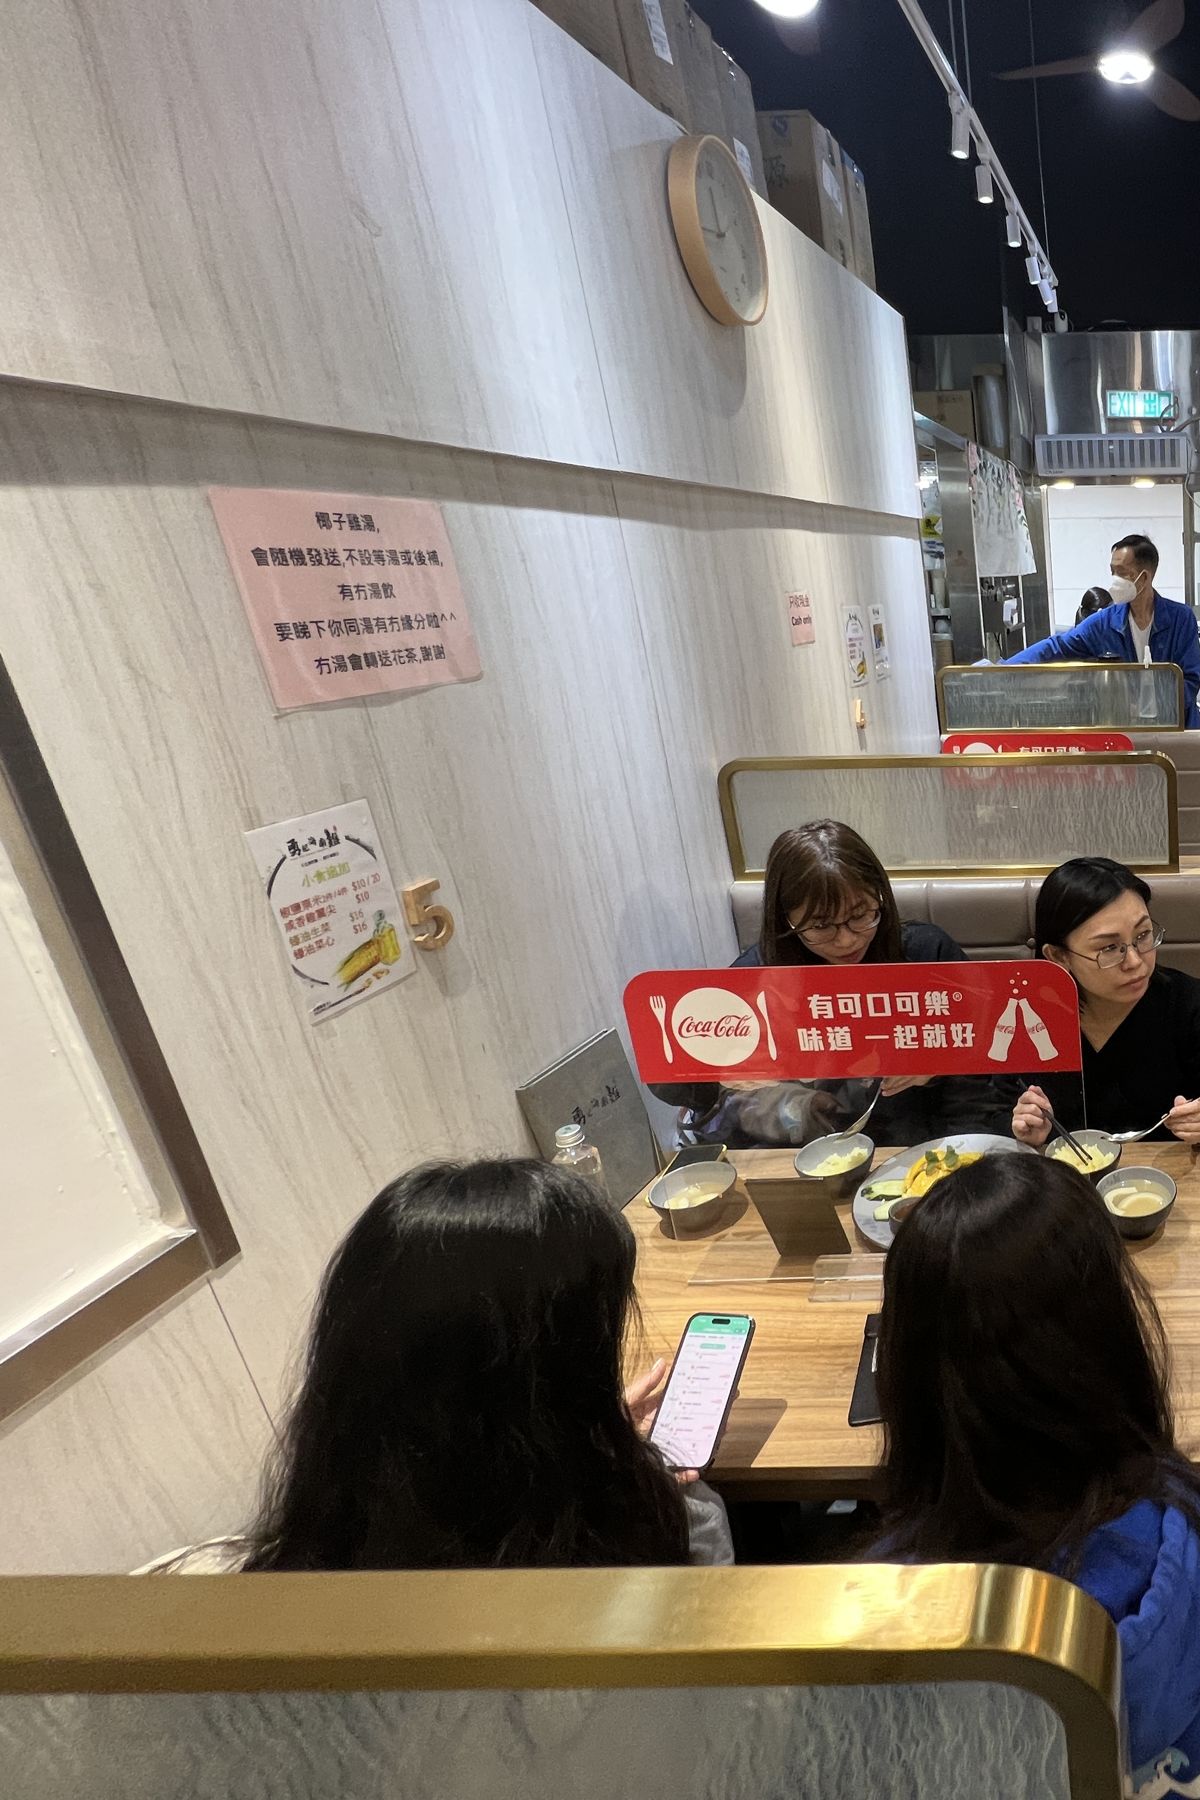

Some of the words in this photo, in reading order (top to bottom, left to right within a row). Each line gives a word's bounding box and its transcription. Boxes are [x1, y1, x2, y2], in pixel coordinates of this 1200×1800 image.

[1109, 392, 1137, 416] EXIT
[1144, 392, 1172, 416] 出口
[337, 583, 397, 602] 有冇湯飲
[402, 878, 454, 951] 5
[677, 1014, 752, 1039] Coca-Cola
[796, 1026, 854, 1053] 味道
[864, 1021, 976, 1050] 一起就好
